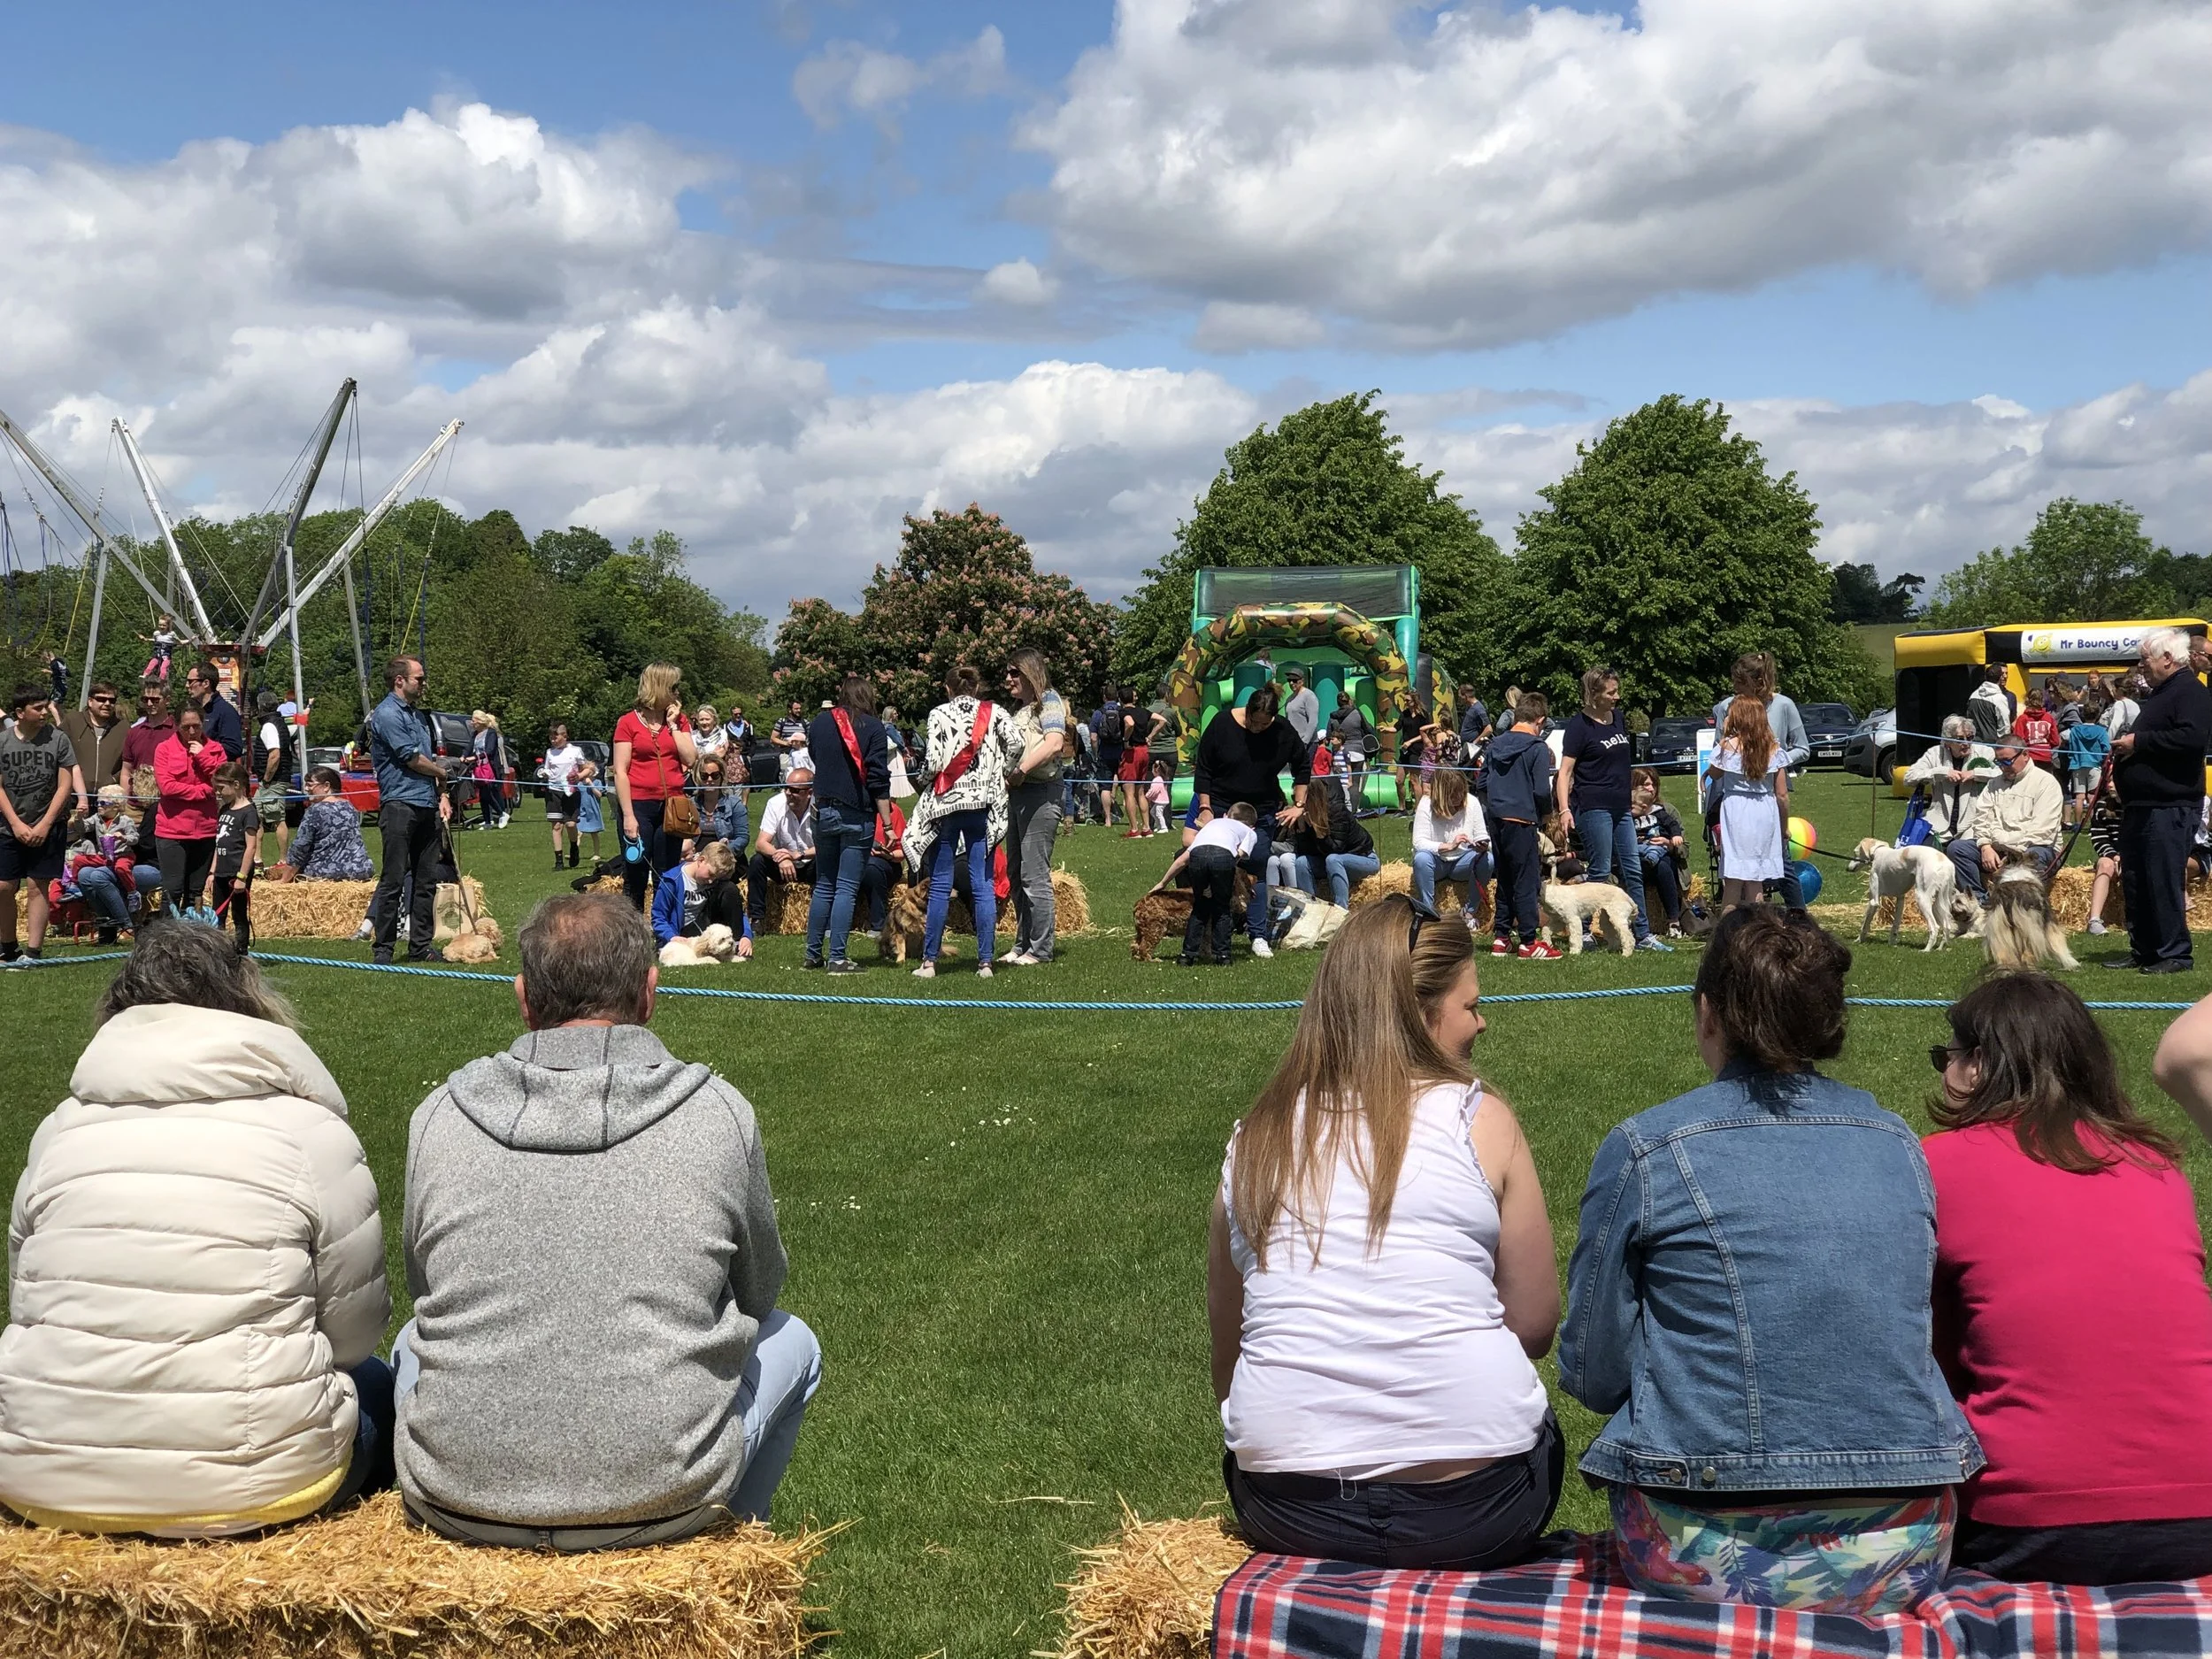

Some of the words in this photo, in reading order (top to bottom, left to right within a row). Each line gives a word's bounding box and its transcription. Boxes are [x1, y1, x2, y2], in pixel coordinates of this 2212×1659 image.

[2060, 639, 2073, 649] Mr
[2077, 638, 2118, 650] Bouncy
[2029, 720, 2049, 741] 19
[1, 750, 55, 771] SUPER
[19, 765, 37, 774] DRY
